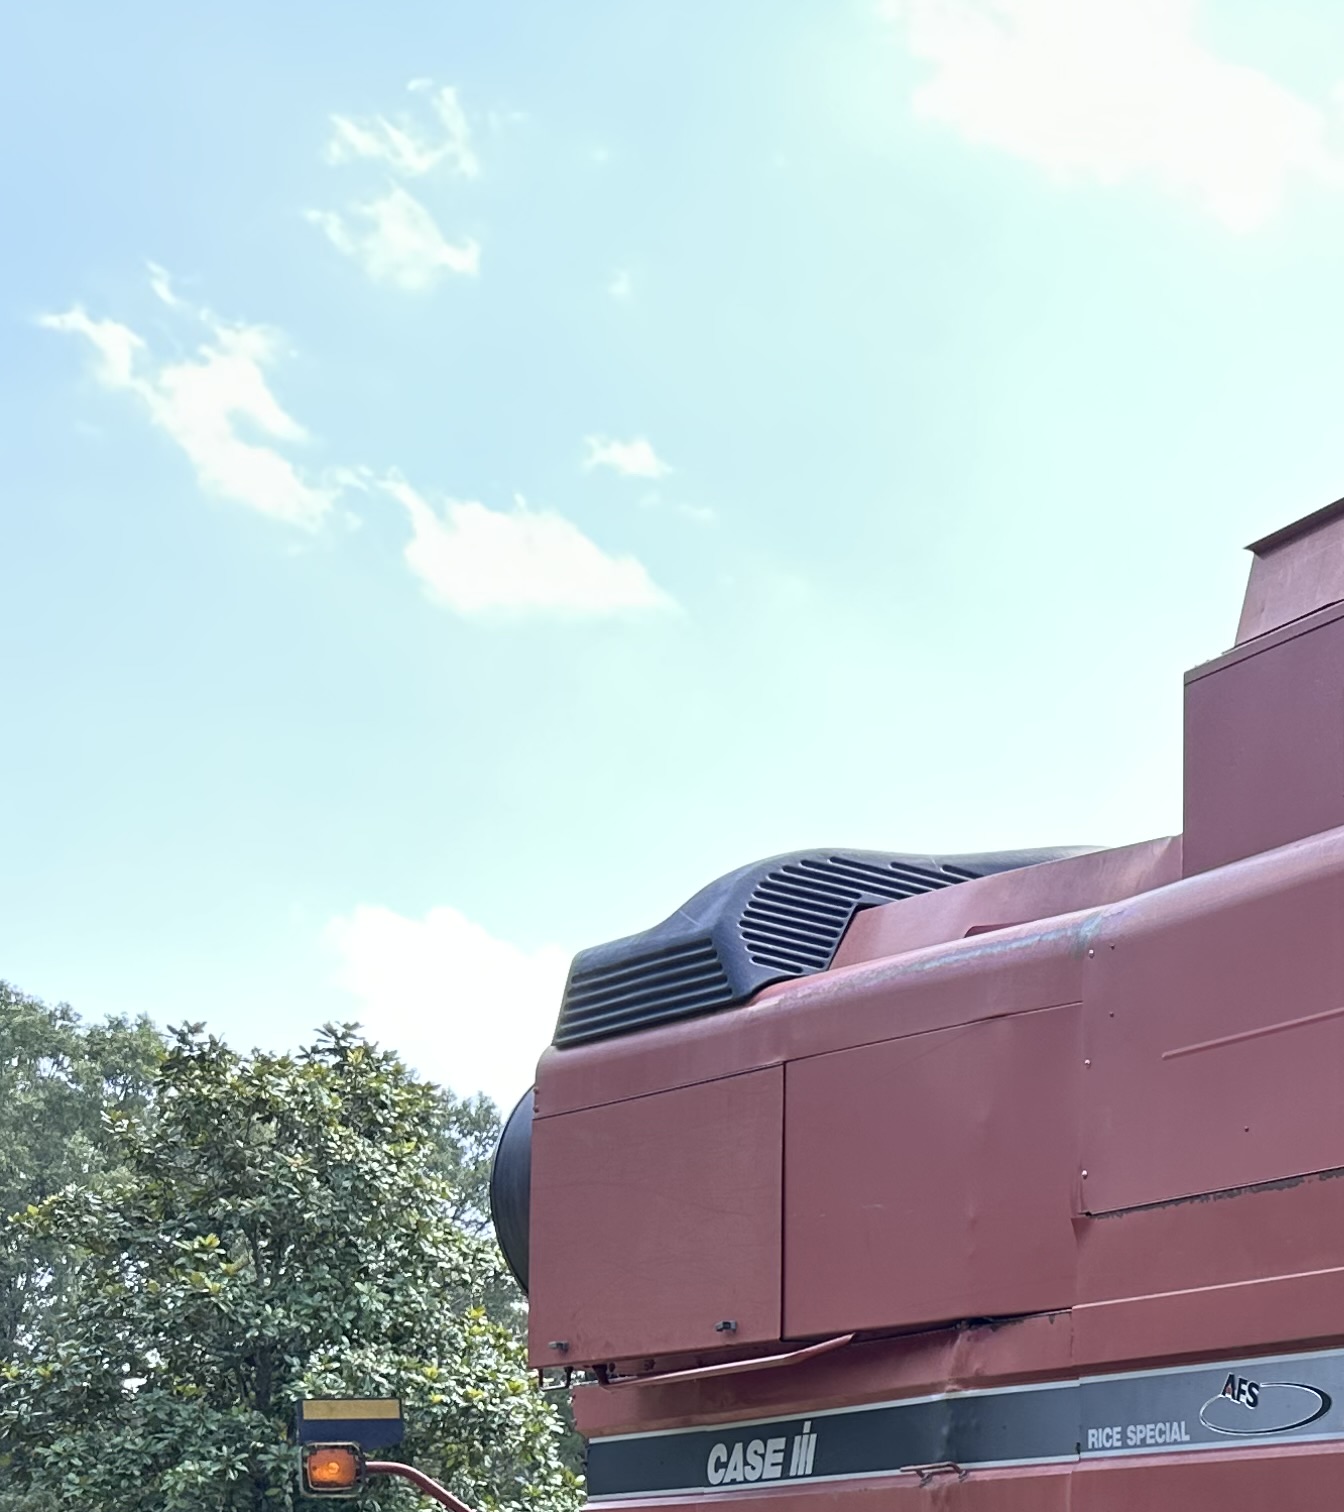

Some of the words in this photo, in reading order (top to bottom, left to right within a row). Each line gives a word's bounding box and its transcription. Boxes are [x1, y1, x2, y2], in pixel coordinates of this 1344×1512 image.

[1220, 1372, 1261, 1410] AFS
[1087, 1426, 1122, 1449] RICE
[1126, 1420, 1191, 1446] SPECIAL
[707, 1437, 787, 1486] CASE
